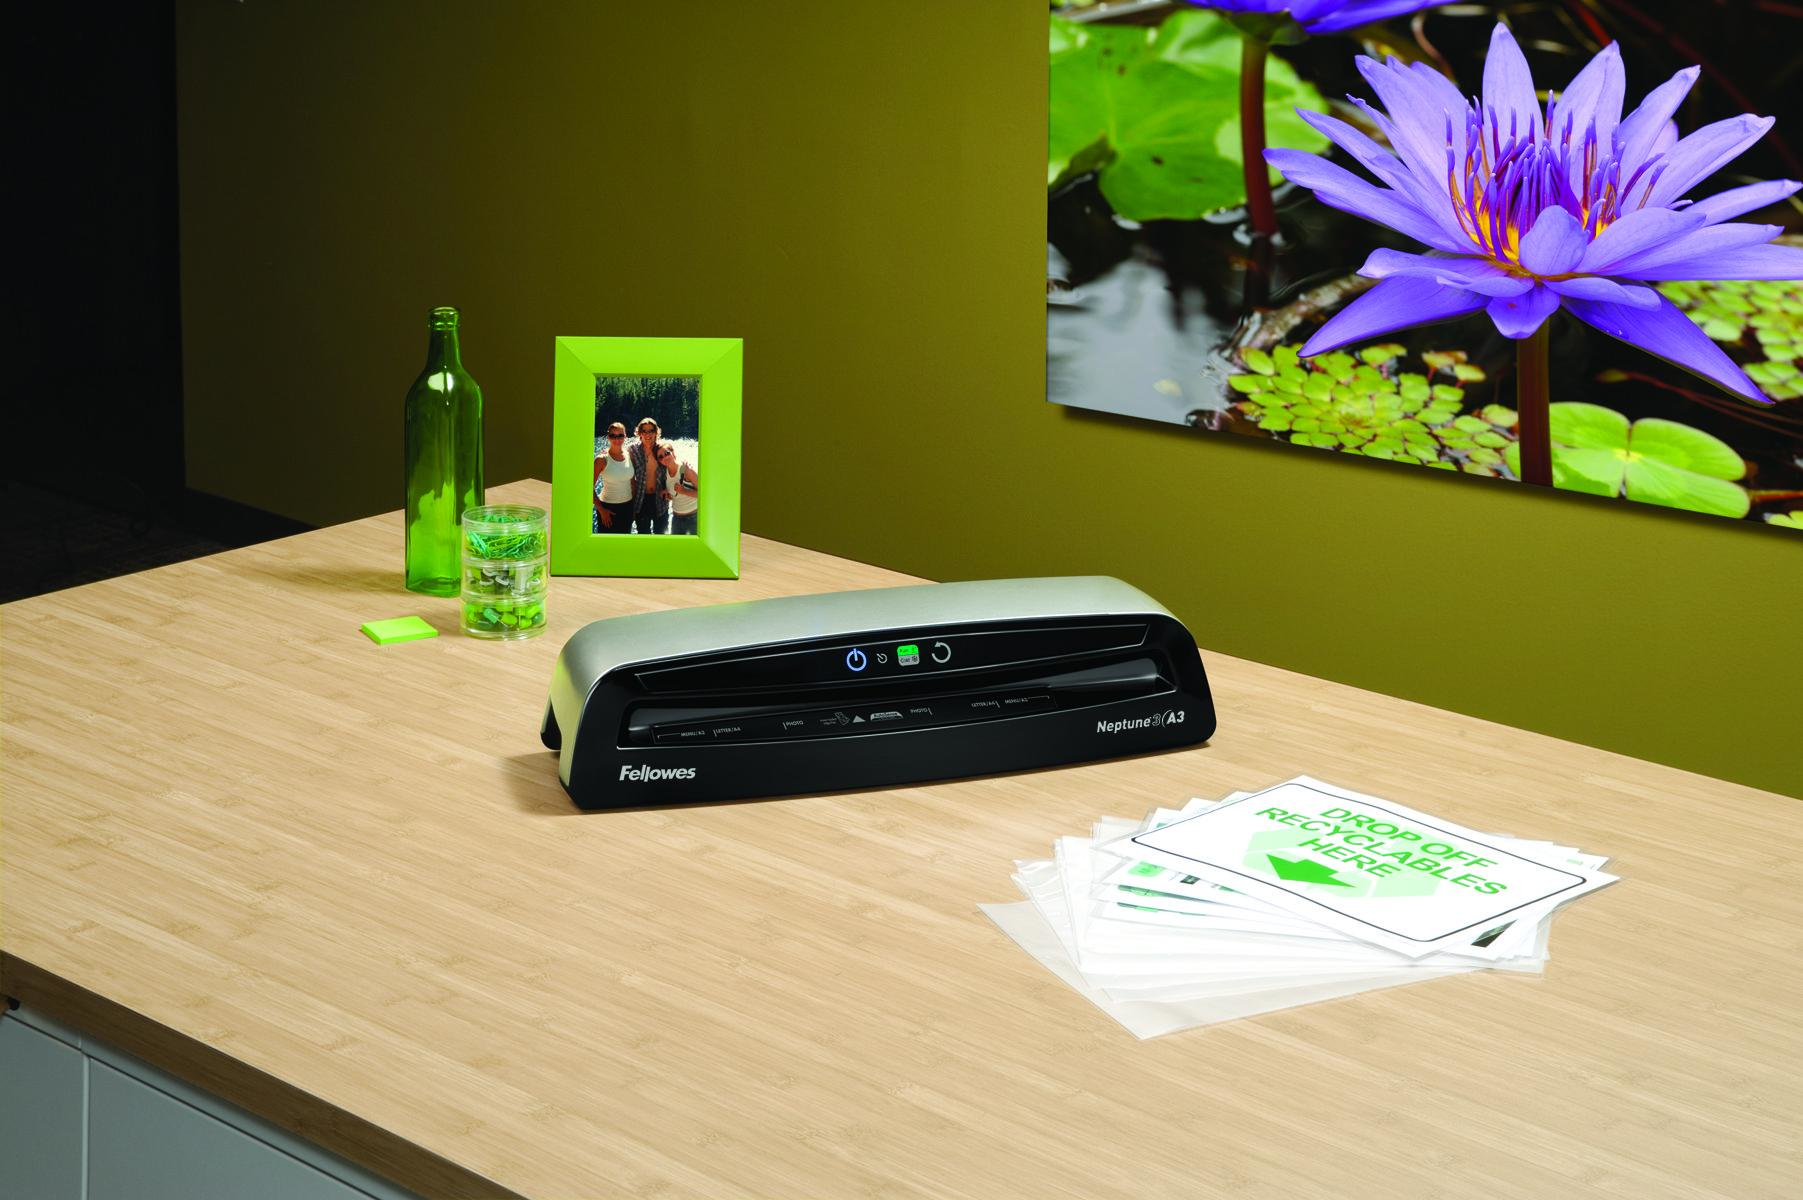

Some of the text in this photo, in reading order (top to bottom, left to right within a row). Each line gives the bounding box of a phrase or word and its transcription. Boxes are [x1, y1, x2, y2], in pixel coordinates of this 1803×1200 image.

[1097, 718, 1151, 733] Neptune
[619, 765, 696, 783] Fellowes
[1255, 807, 1508, 896] RECYCLABLES
[1297, 838, 1402, 879] HERE
[1319, 807, 1499, 869] DROP OFF
